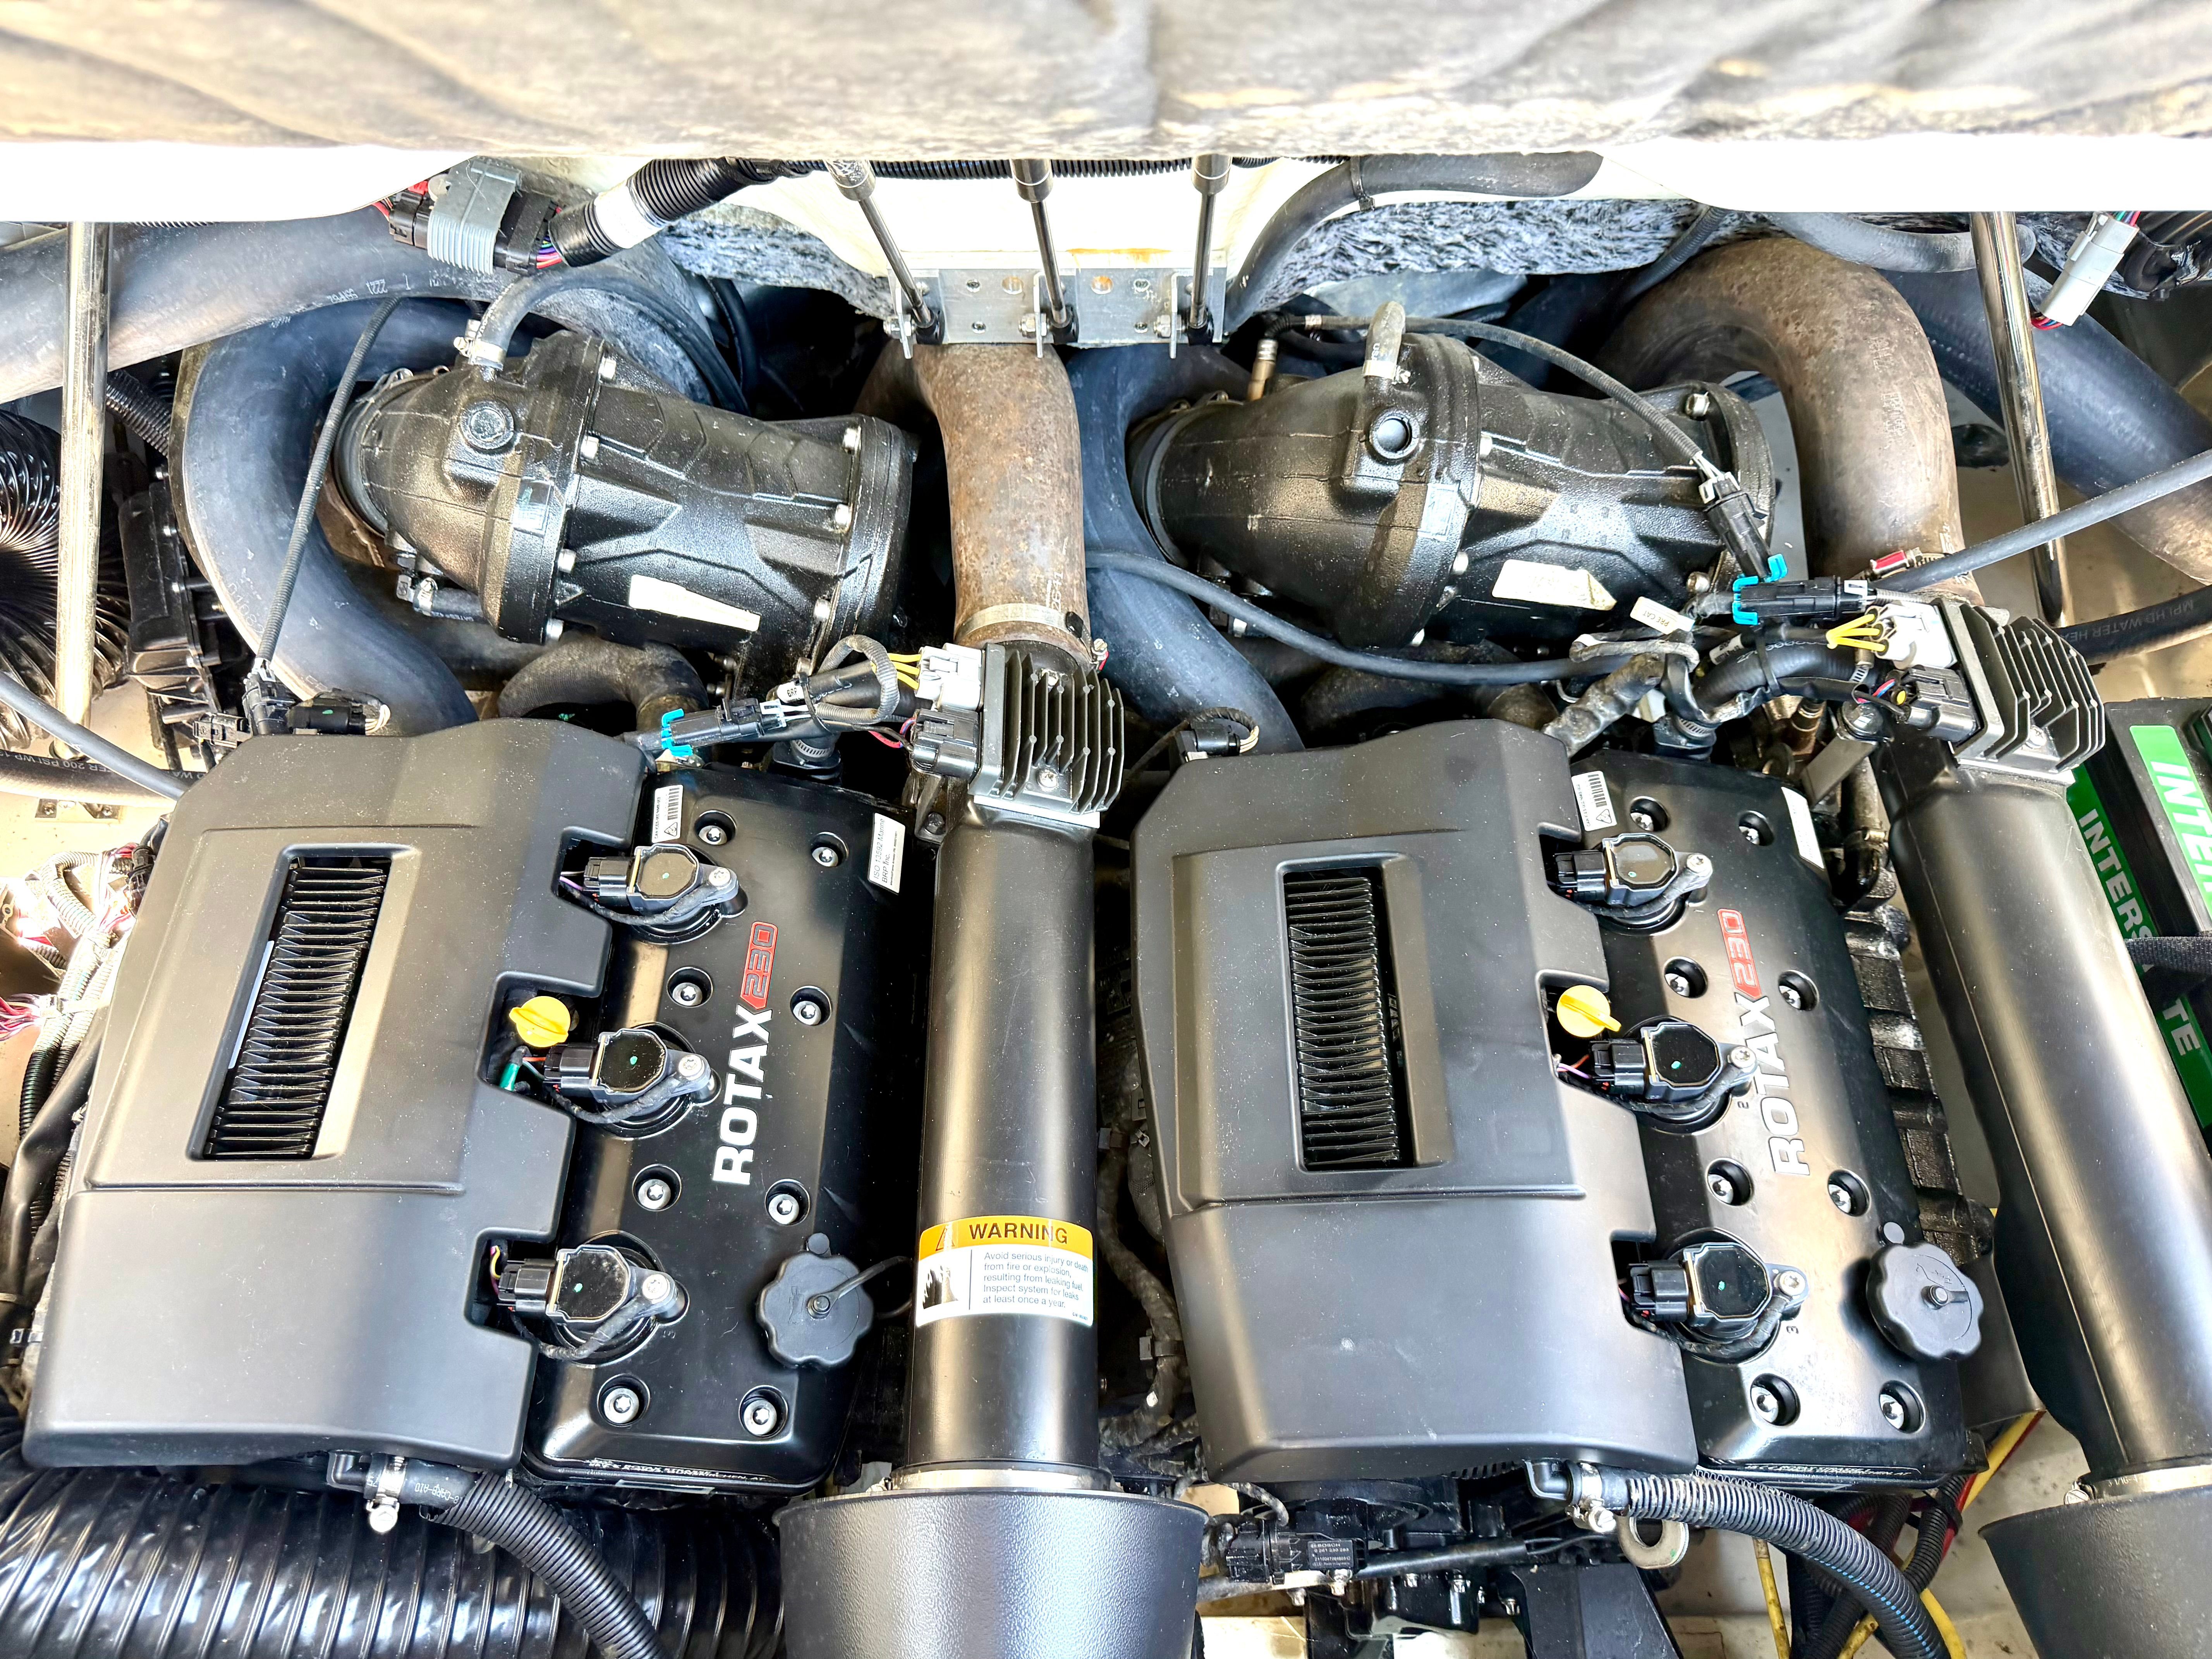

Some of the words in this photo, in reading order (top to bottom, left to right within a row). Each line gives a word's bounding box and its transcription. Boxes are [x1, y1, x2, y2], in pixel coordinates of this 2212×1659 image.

[1642, 610, 1656, 620] CAT
[1656, 617, 1670, 627] PRE
[2092, 617, 2142, 637] WATER
[787, 687, 797, 697] BRP
[37, 757, 59, 766] PSI
[63, 761, 85, 769] 200
[875, 842, 883, 863] 13592
[882, 854, 890, 866] Inc.
[1721, 911, 1758, 988] 230
[713, 1004, 773, 1185] ROTAX
[743, 924, 776, 999] 230
[1735, 992, 1810, 1176] ROTAX
[969, 1223, 1067, 1244] WARNING
[984, 1252, 1009, 1260] Avoid
[1012, 1252, 1042, 1261] serious
[1045, 1254, 1065, 1266] injury
[1074, 1261, 1088, 1273] death
[984, 1262, 1004, 1271] from
[1034, 1265, 1072, 1278] explosion,
[984, 1273, 1021, 1283] resulting
[1024, 1273, 1042, 1283] from
[1045, 1276, 1070, 1289] leaking
[1072, 1281, 1083, 1291] fuel.
[984, 1284, 1015, 1293] Inspect
[1018, 1285, 1048, 1294] system
[1051, 1287, 1061, 1295] for
[1063, 1289, 1079, 1300] leaks
[994, 1295, 1015, 1303] least
[1049, 1299, 1065, 1308] year.
